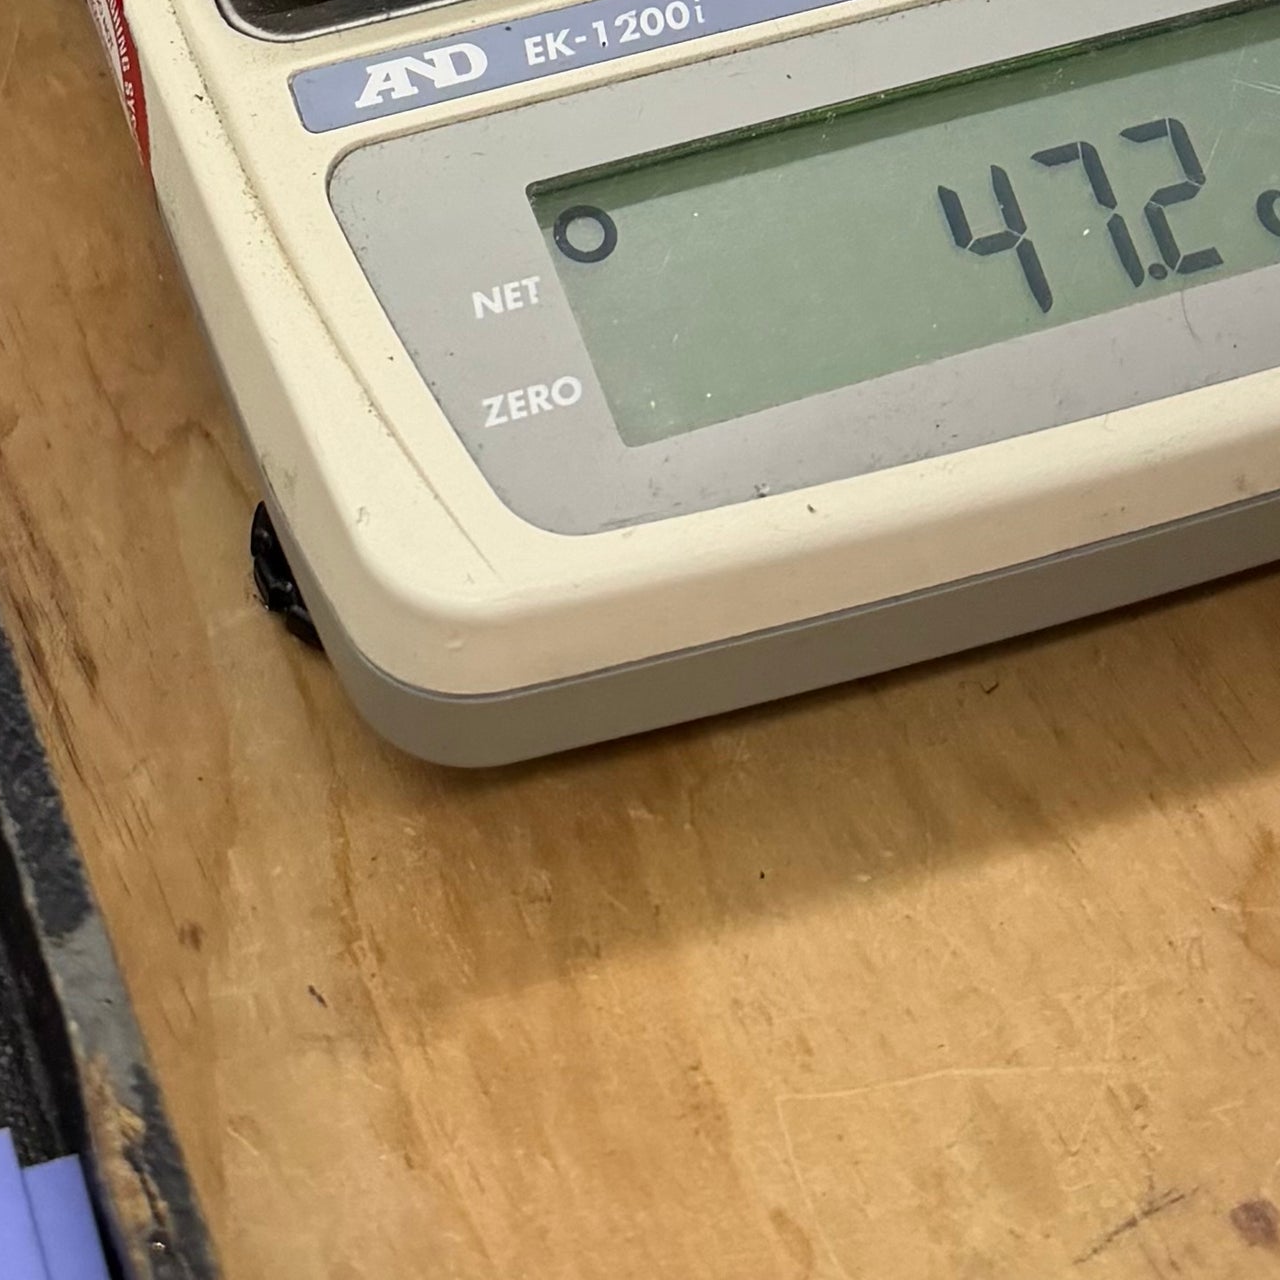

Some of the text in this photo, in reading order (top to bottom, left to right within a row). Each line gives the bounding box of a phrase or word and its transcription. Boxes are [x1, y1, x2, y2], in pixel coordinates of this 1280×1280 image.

[935, 116, 1225, 315] 47.2
[471, 276, 543, 321] NET
[482, 374, 584, 431] ZERO
